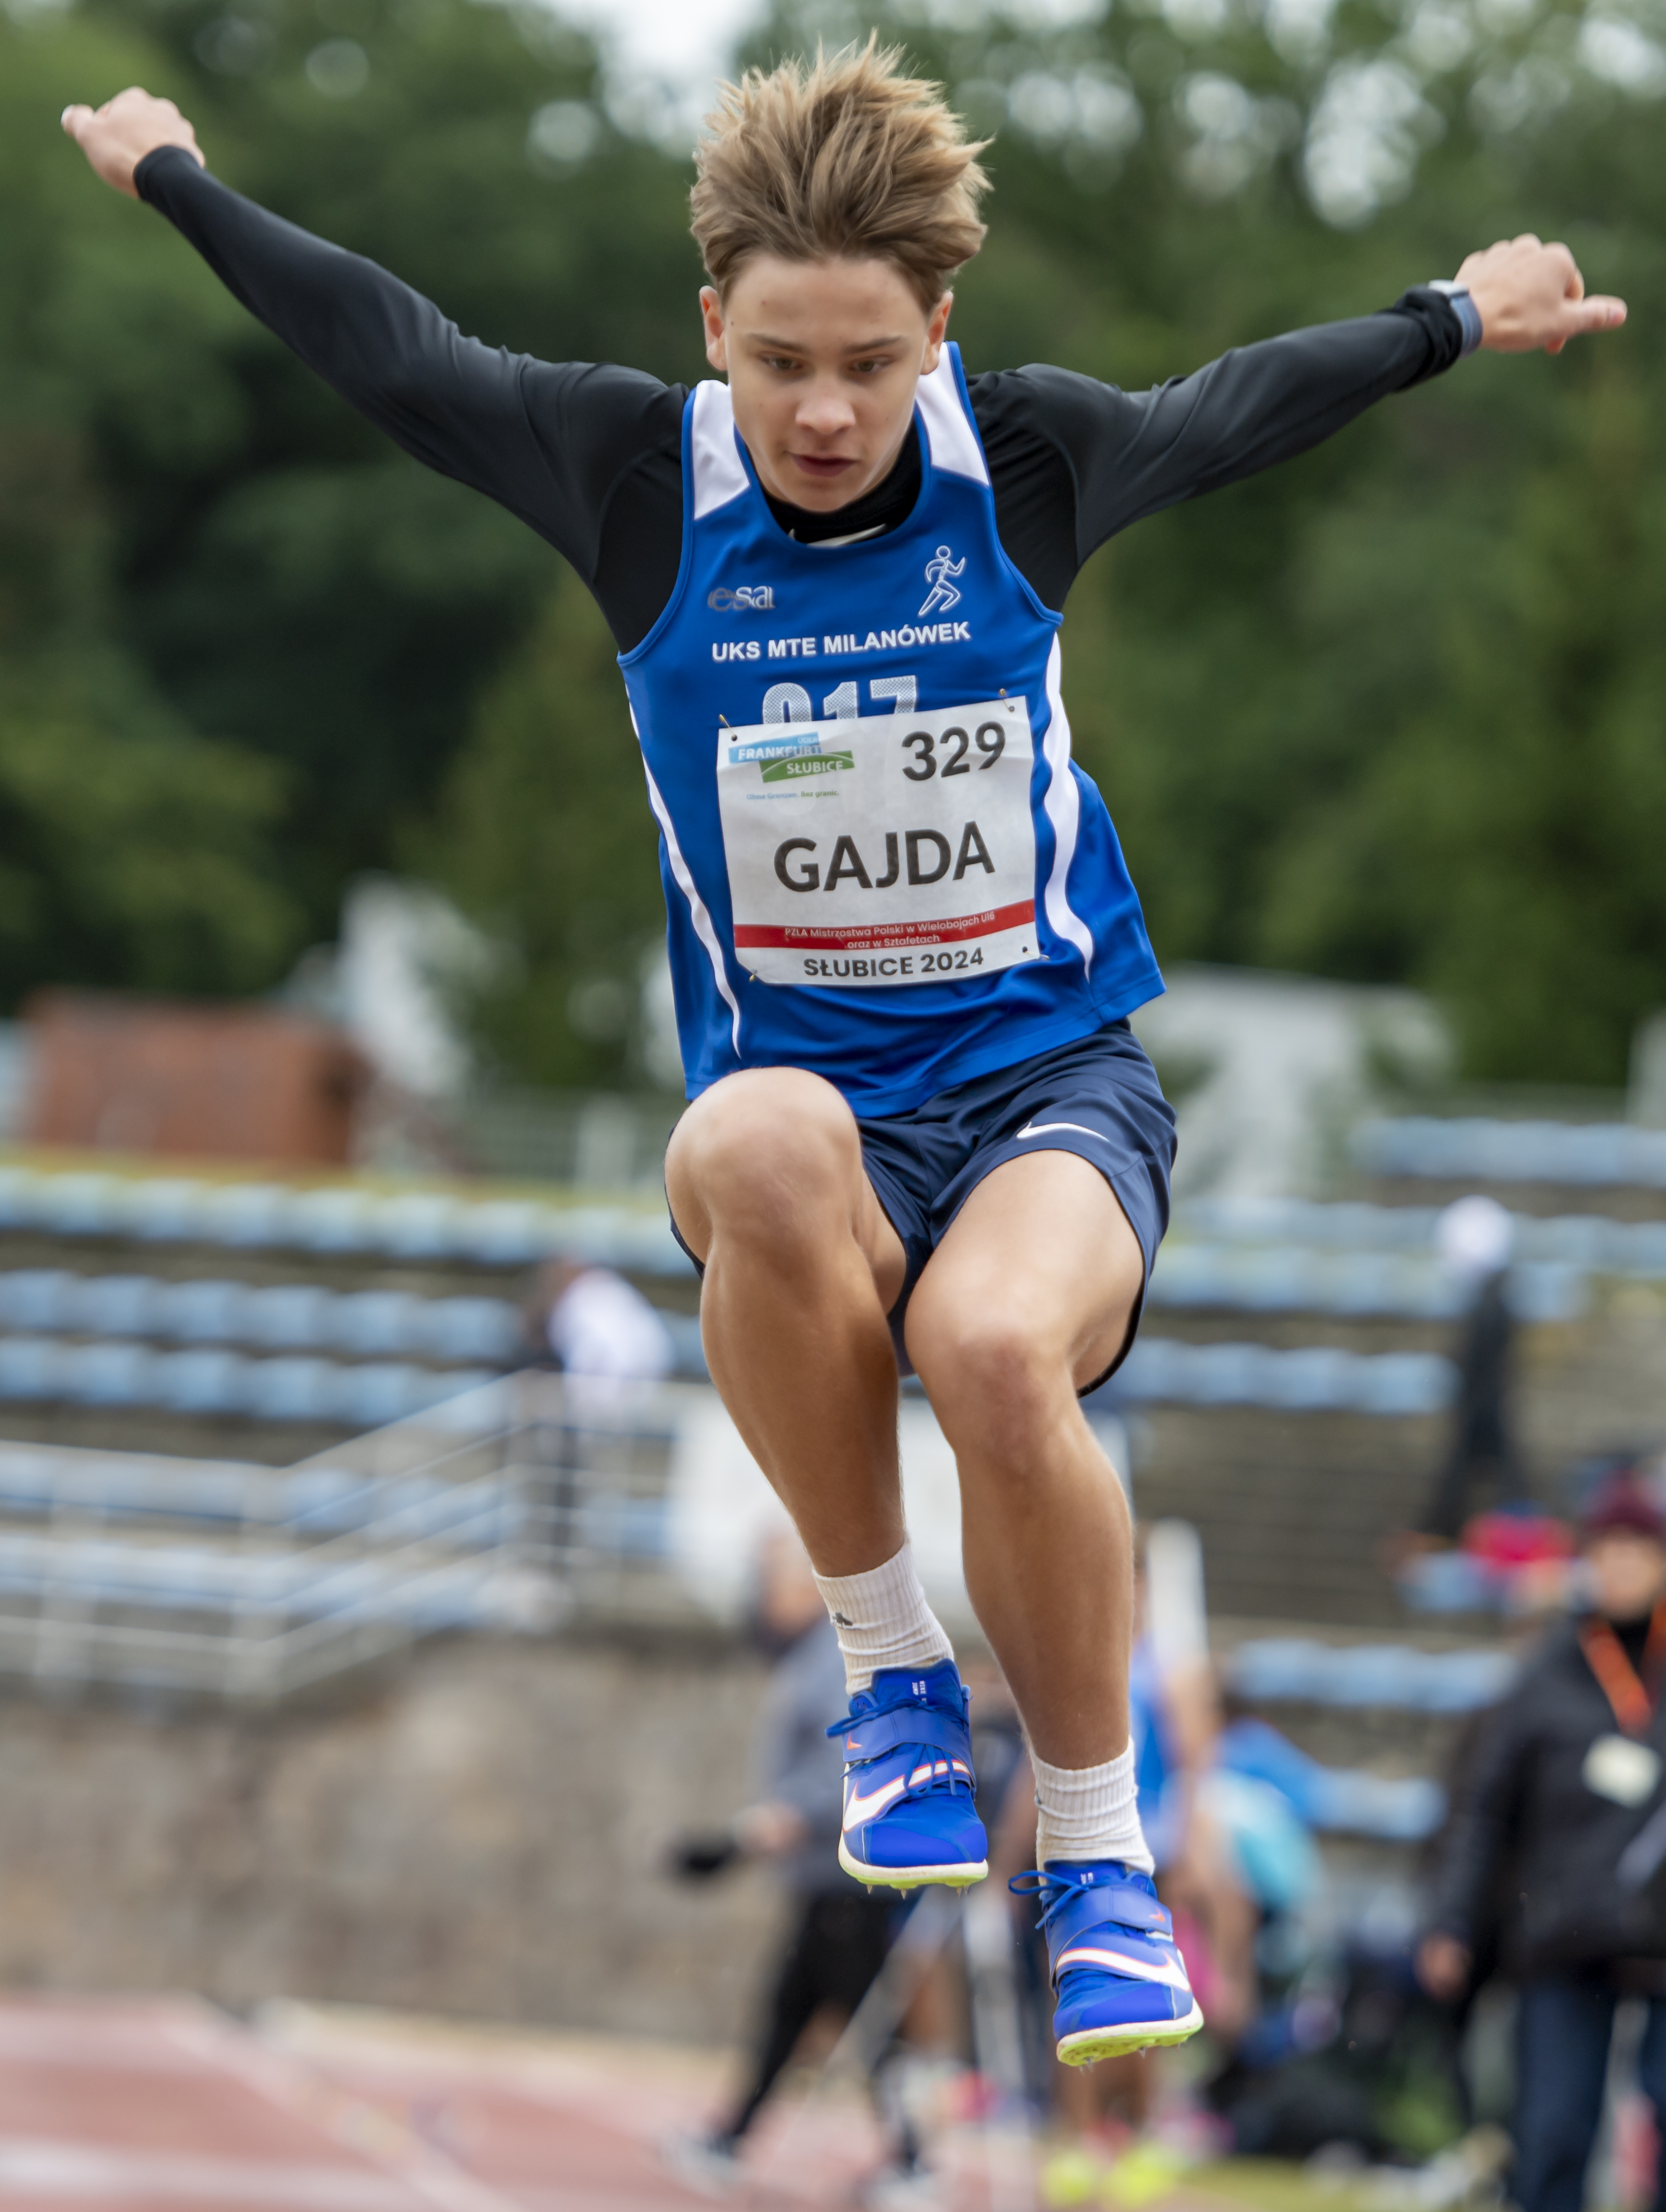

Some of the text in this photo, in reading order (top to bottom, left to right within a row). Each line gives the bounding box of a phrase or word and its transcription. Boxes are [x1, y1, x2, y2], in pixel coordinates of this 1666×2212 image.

[712, 621, 971, 662] UKS MTE MILANÓWEK
[738, 745, 820, 760] FRANKFURT
[797, 736, 818, 744] ODER
[902, 721, 1006, 782] 329
[786, 760, 843, 774] SŁUBICE
[774, 820, 995, 892] GAJDA
[785, 927, 808, 936] PZLA
[810, 928, 872, 937] Mistrzostwa
[873, 924, 904, 935] Polski
[917, 915, 980, 931] Wielobojach
[981, 910, 995, 922] U16
[847, 934, 940, 949] oraz w Sztafetach
[803, 946, 984, 977] SŁUBICE 2024
